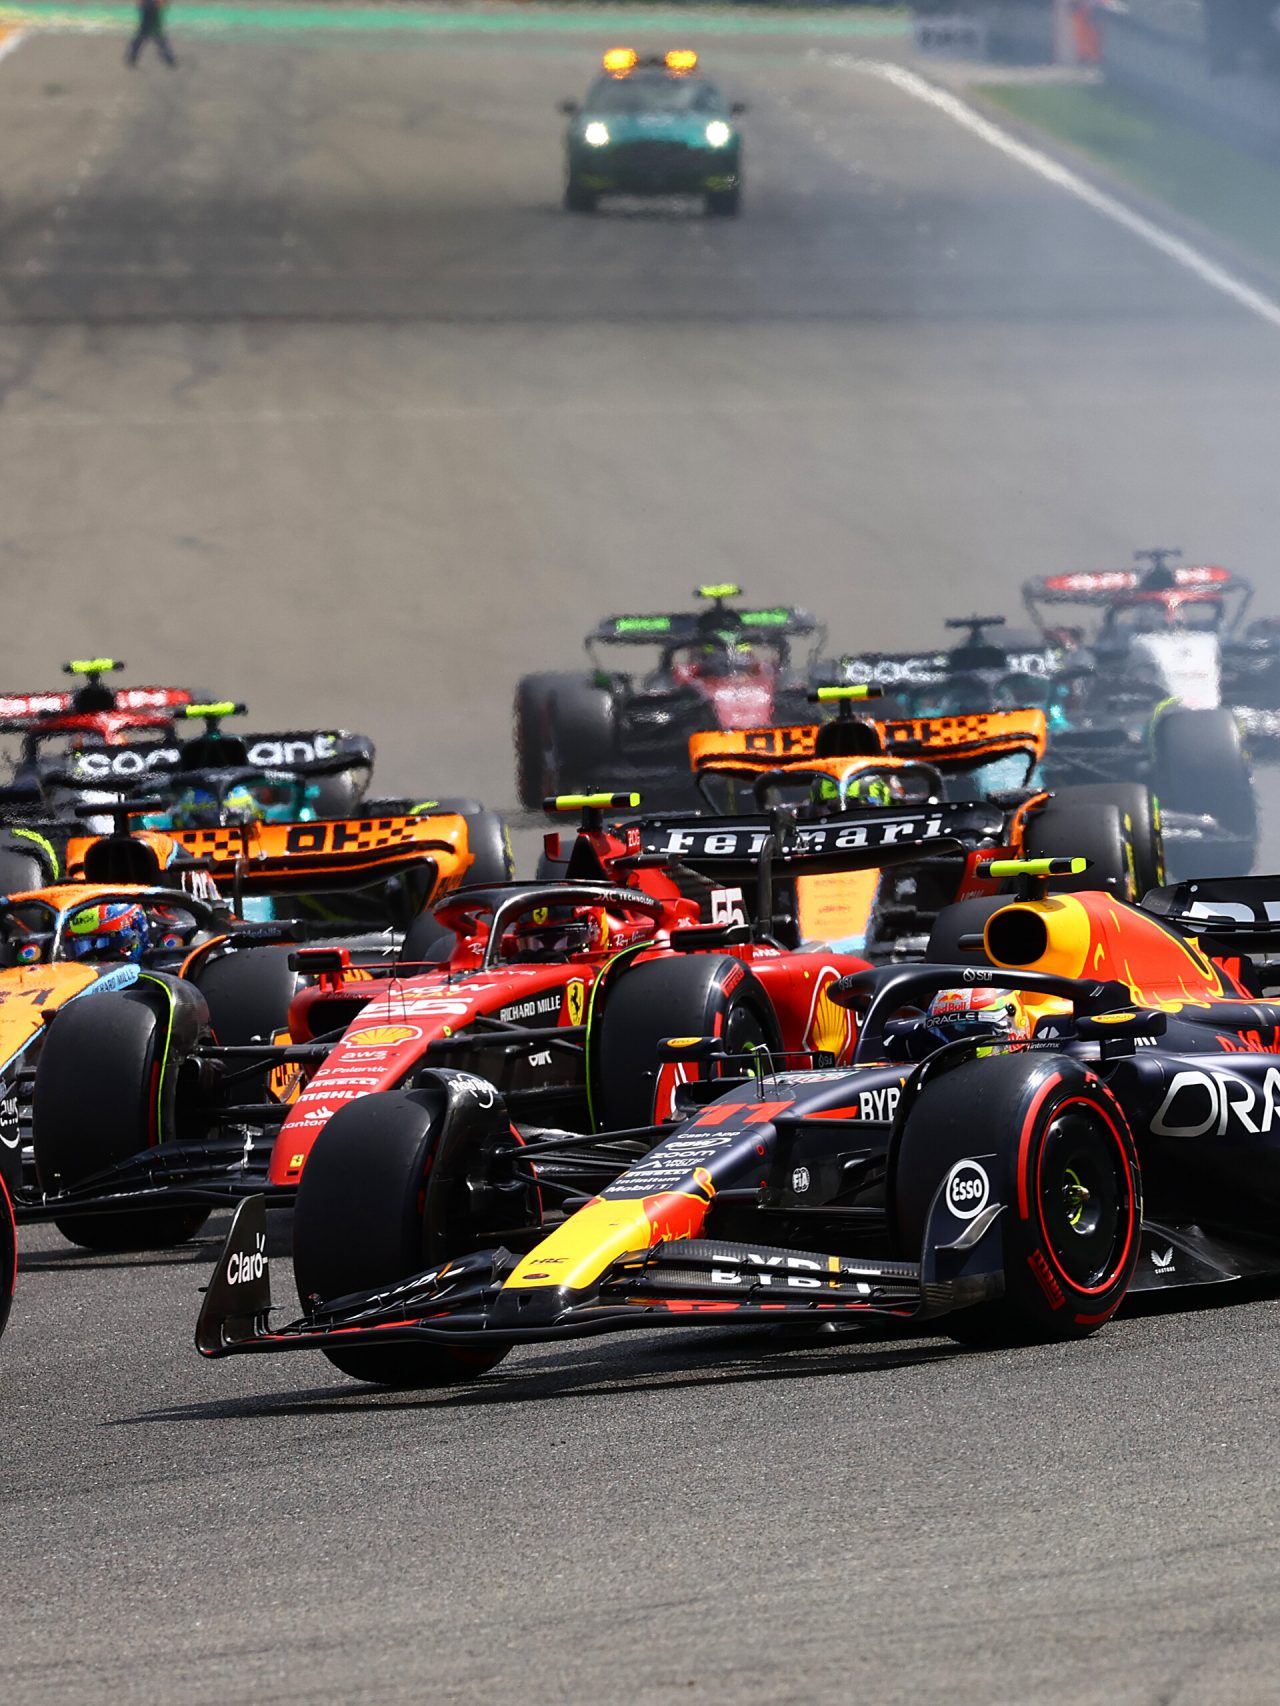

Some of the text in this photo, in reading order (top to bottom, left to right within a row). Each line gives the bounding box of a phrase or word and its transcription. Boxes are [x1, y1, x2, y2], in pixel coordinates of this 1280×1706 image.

[500, 994, 562, 1023] RICHARD MILLE
[926, 1011, 977, 1028] ORACLE
[341, 1050, 388, 1061] aws
[331, 1065, 389, 1074] Palantir
[693, 1100, 796, 1127] 11
[649, 1150, 716, 1159] zoom
[605, 1184, 654, 1193] Mobil
[952, 1177, 983, 1202] Esso
[226, 1249, 263, 1286] Claro
